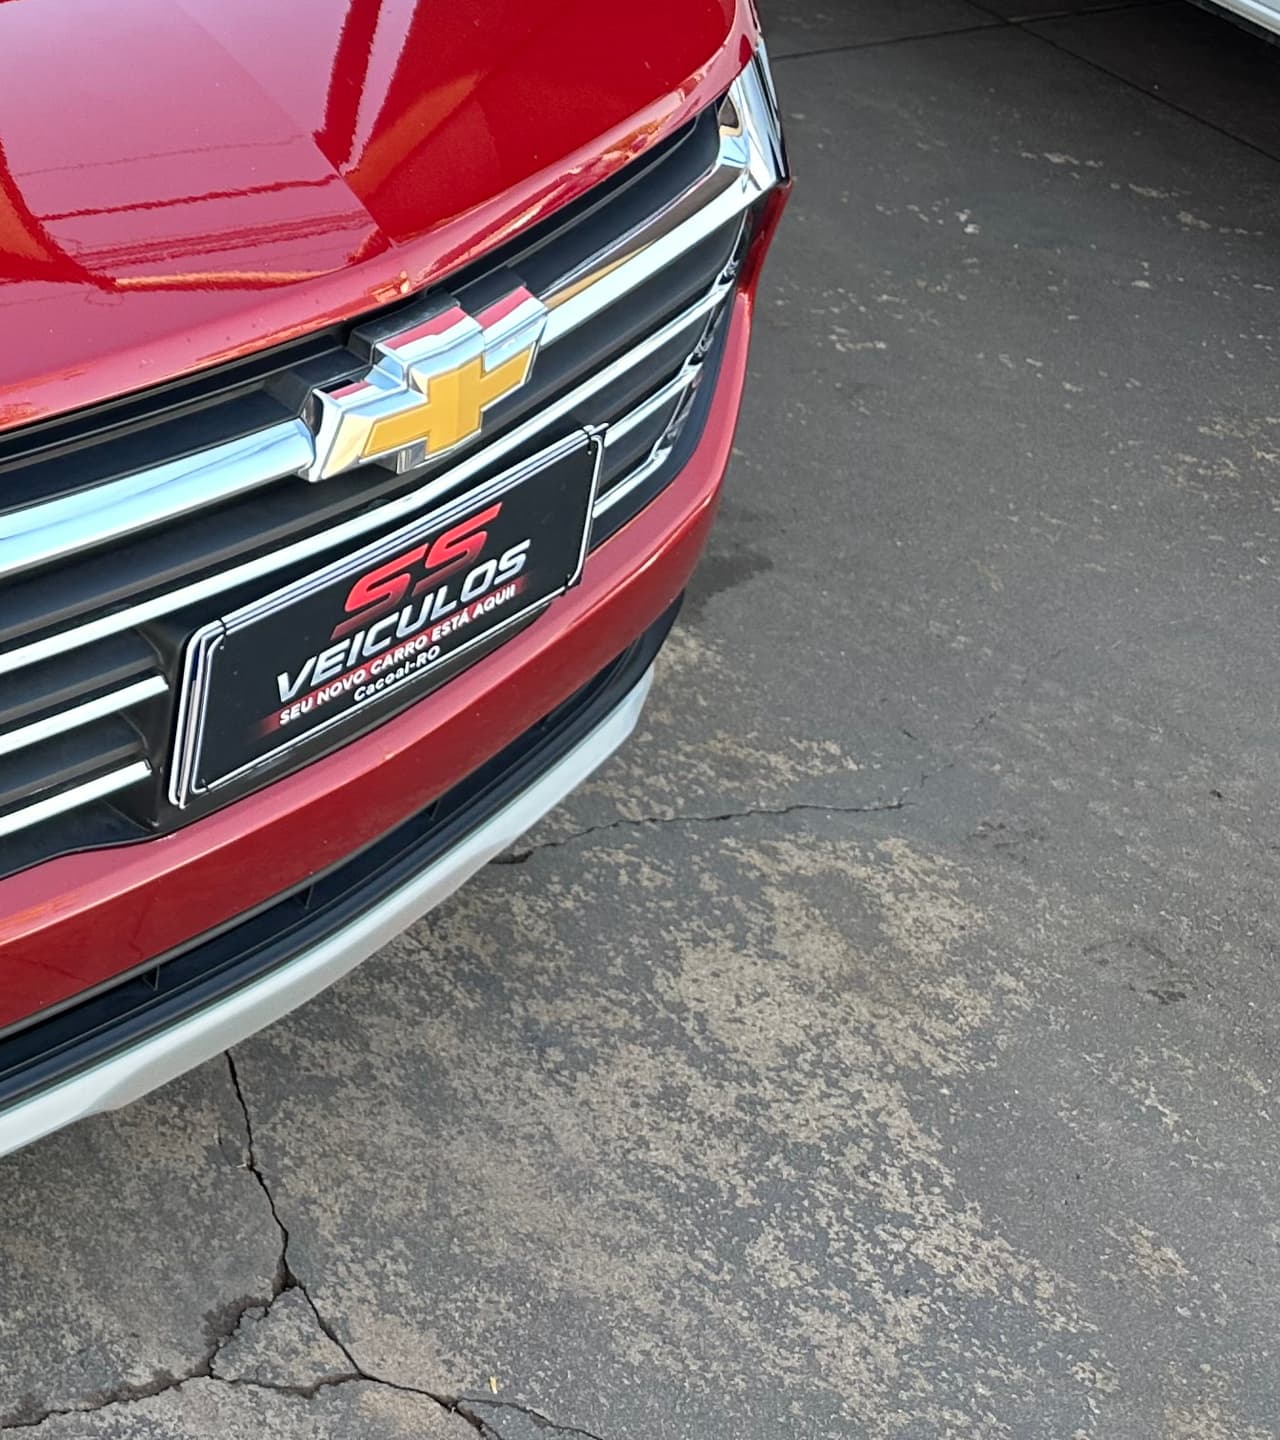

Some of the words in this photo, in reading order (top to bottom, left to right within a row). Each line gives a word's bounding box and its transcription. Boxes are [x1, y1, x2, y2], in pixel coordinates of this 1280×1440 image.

[277, 539, 531, 703] VEICULOS
[279, 697, 313, 725] SEU
[316, 668, 366, 706] NOVO
[370, 634, 428, 675] CARRO
[431, 607, 469, 642] ESTÁ
[353, 645, 441, 702] Cacoal-RO
